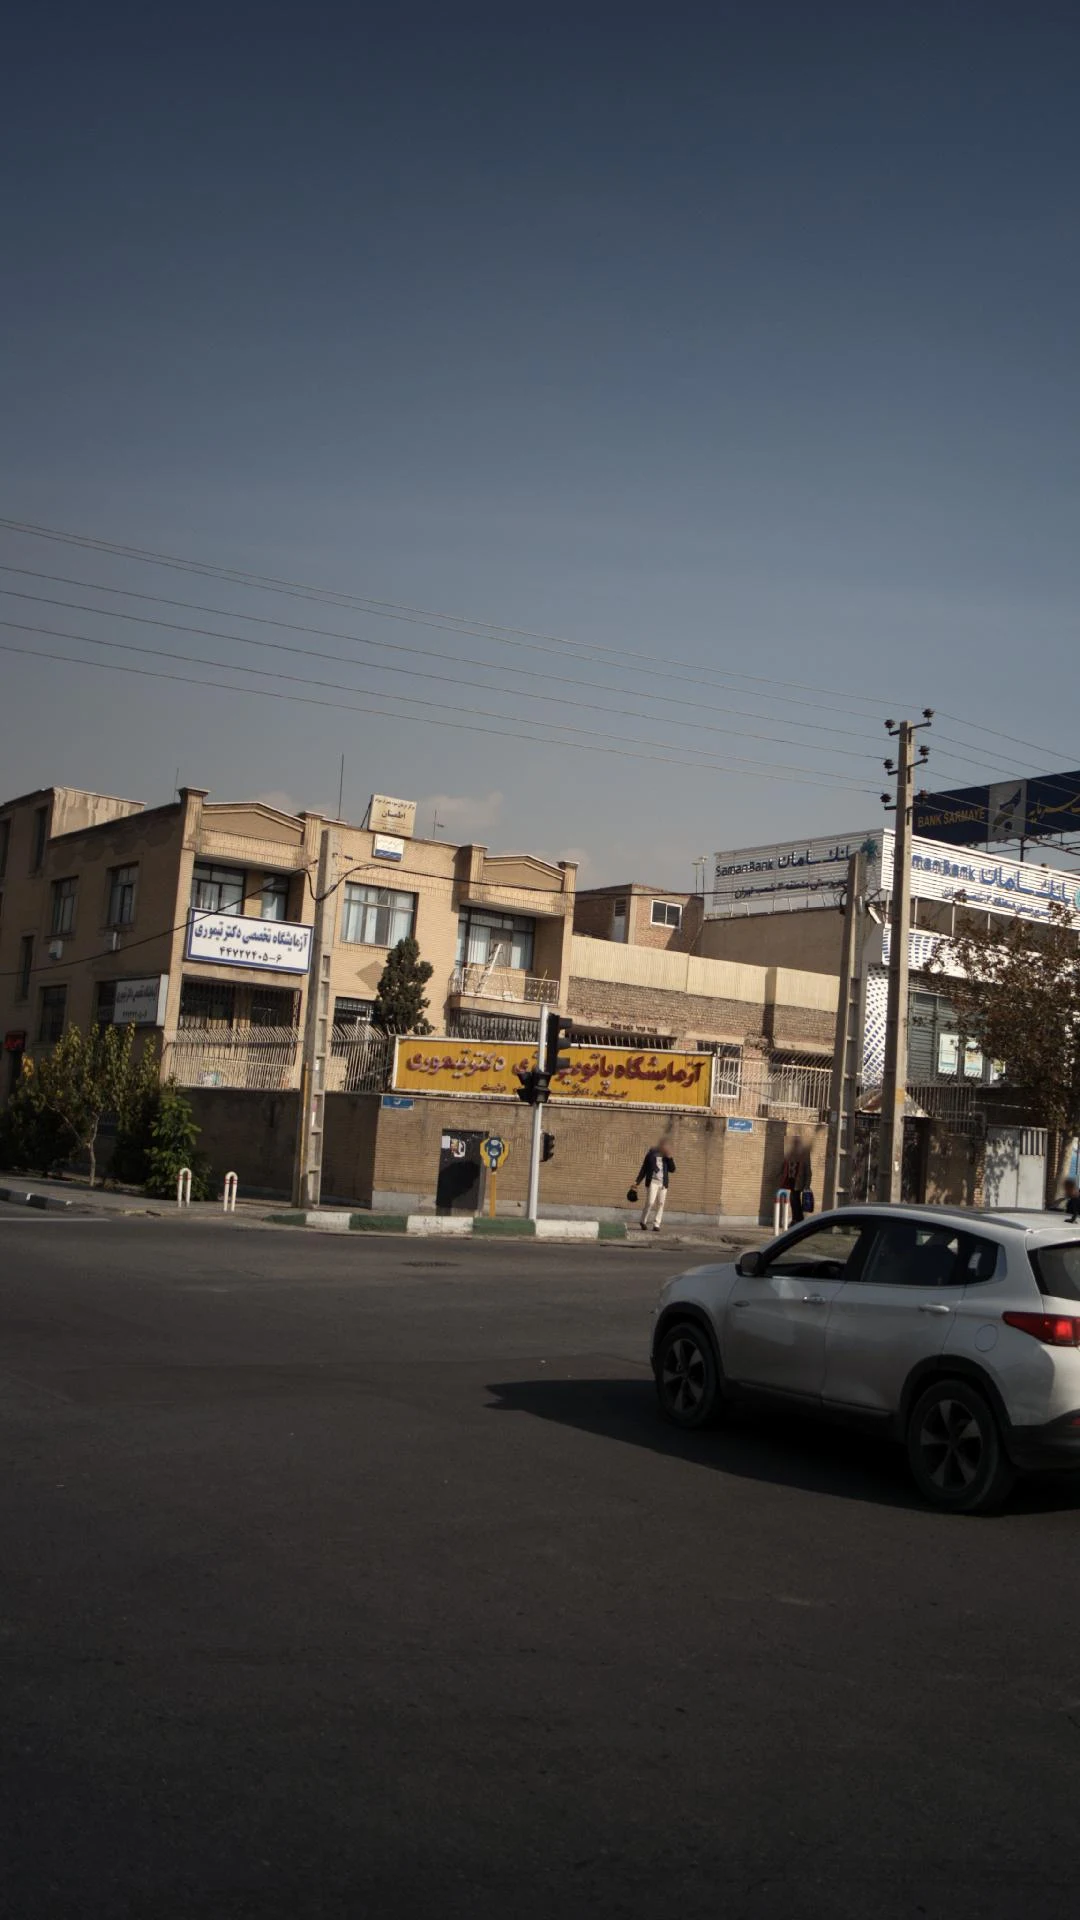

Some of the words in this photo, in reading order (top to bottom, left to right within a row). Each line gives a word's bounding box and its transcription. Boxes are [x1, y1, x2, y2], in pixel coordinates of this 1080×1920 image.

[918, 815, 942, 828] BANK
[943, 807, 985, 826] SARMAYE
[194, 921, 225, 941] تیموری
[223, 925, 242, 942] دکتر
[242, 927, 272, 945] تخصصی
[272, 931, 309, 952] آزمایشگاه
[406, 1047, 471, 1079] تیموری
[464, 1052, 507, 1077] دکتر
[614, 1055, 706, 1091] آزمایشگاه
